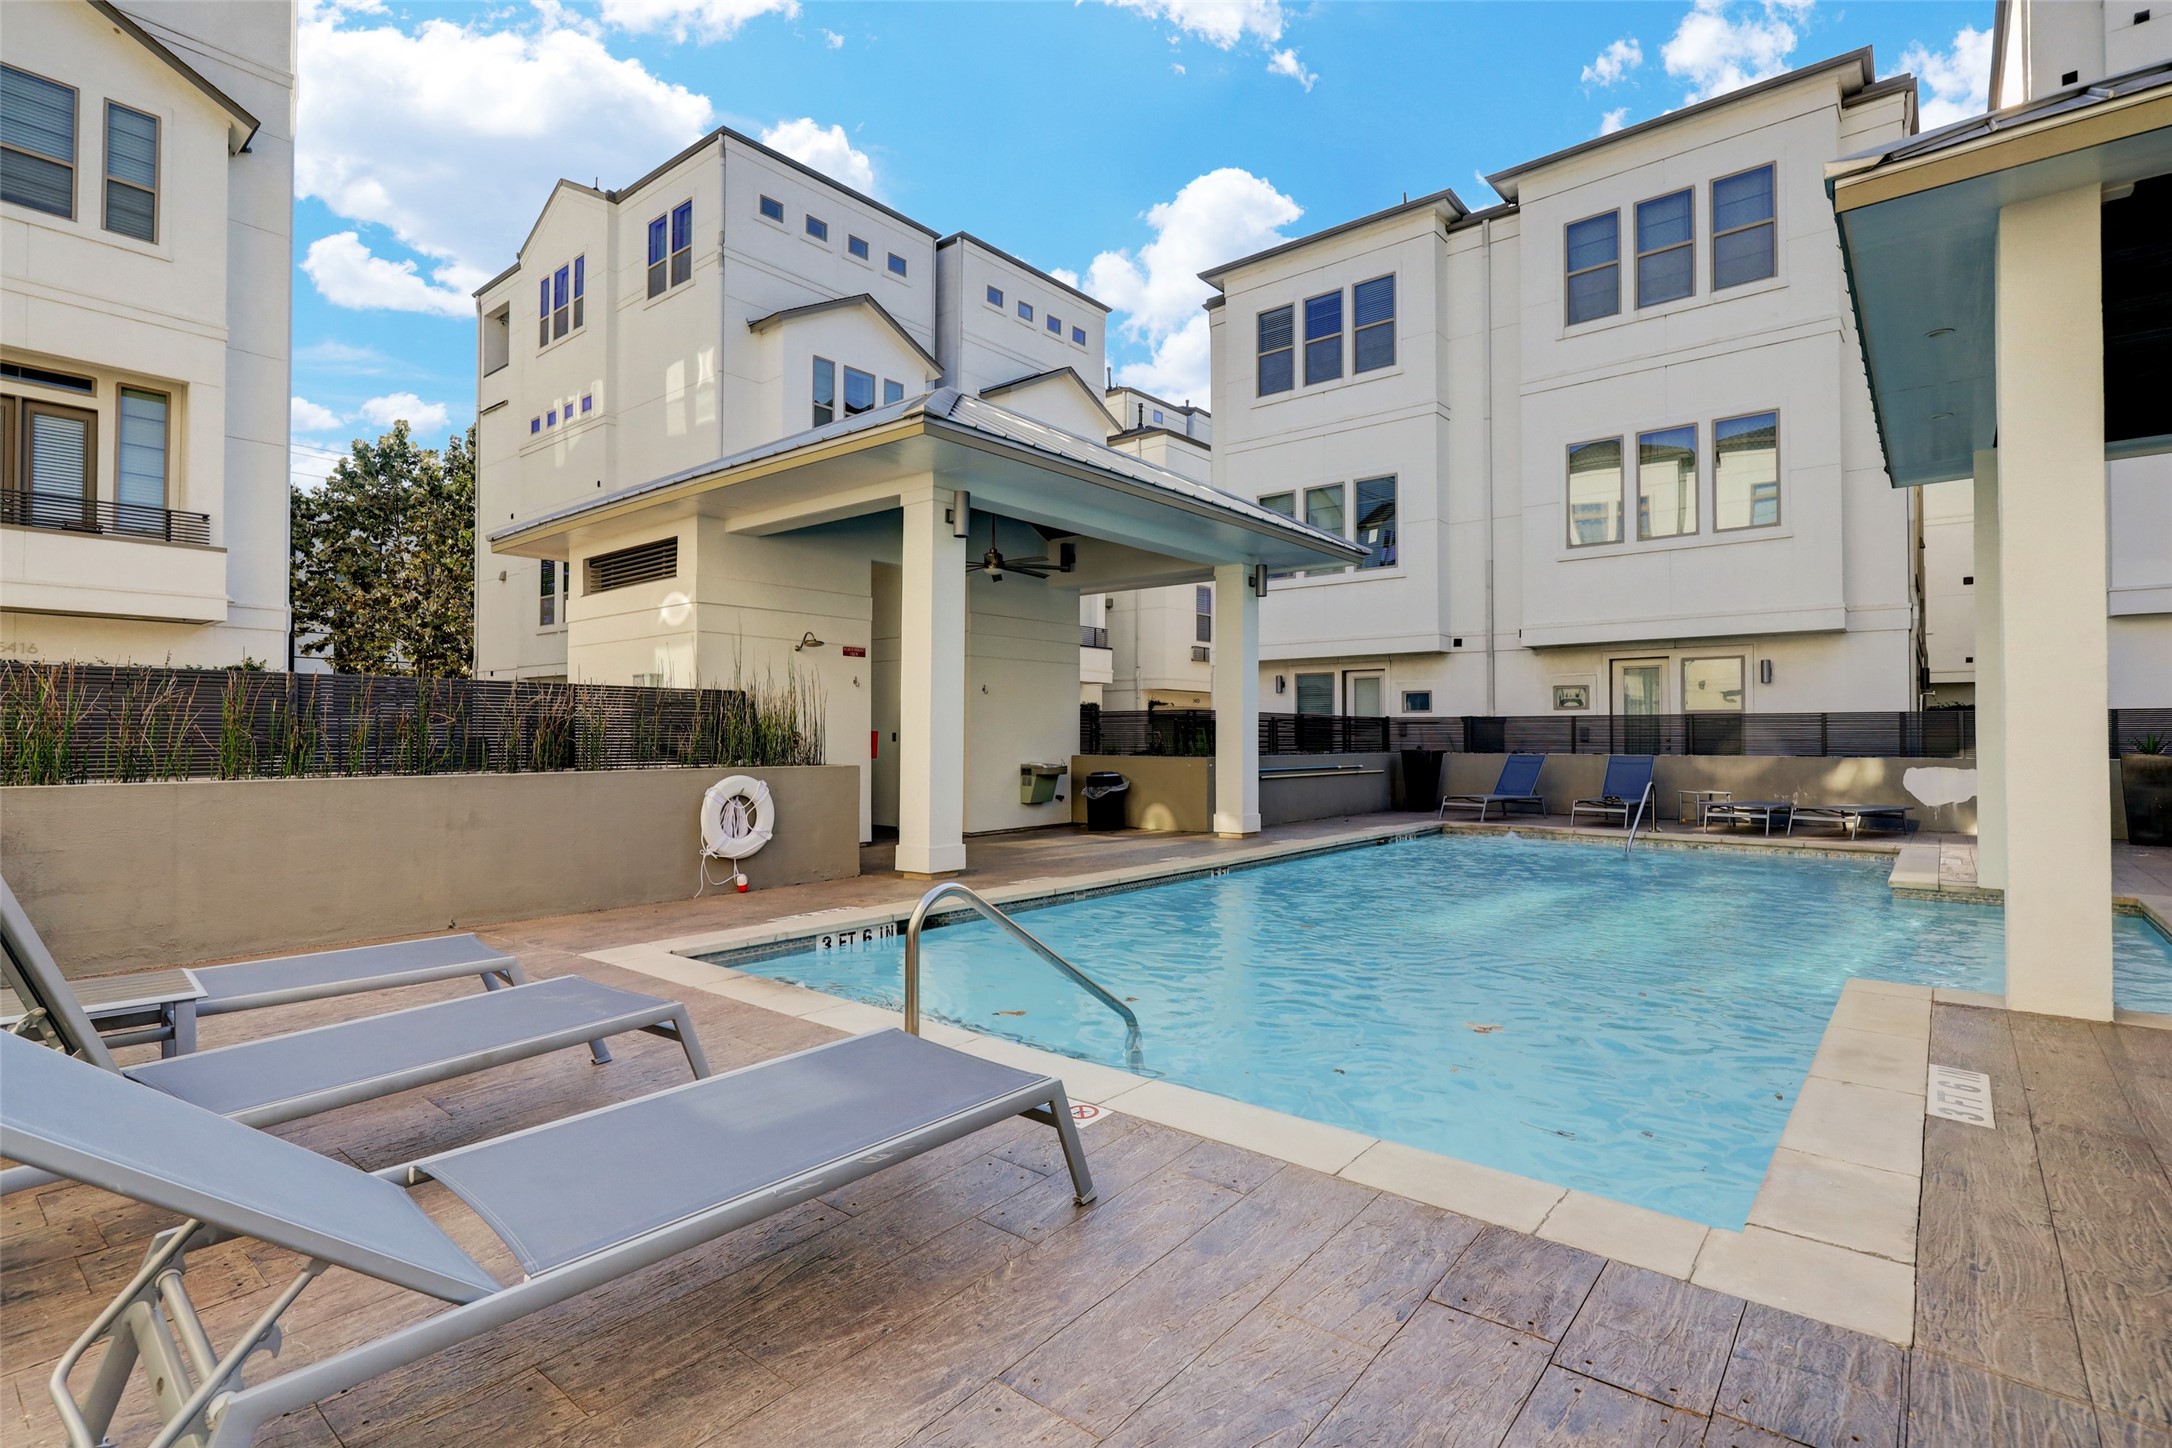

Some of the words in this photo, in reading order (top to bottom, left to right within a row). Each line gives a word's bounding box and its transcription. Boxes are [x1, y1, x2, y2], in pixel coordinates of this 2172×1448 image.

[822, 935, 832, 949] 3
[839, 931, 856, 947] FT
[863, 928, 873, 942] 6
[880, 924, 894, 939] IN
[1937, 1066, 1981, 1083] IN
[1937, 1081, 1981, 1093] 6
[1937, 1090, 1984, 1110] FT
[1937, 1107, 1984, 1121] 3
